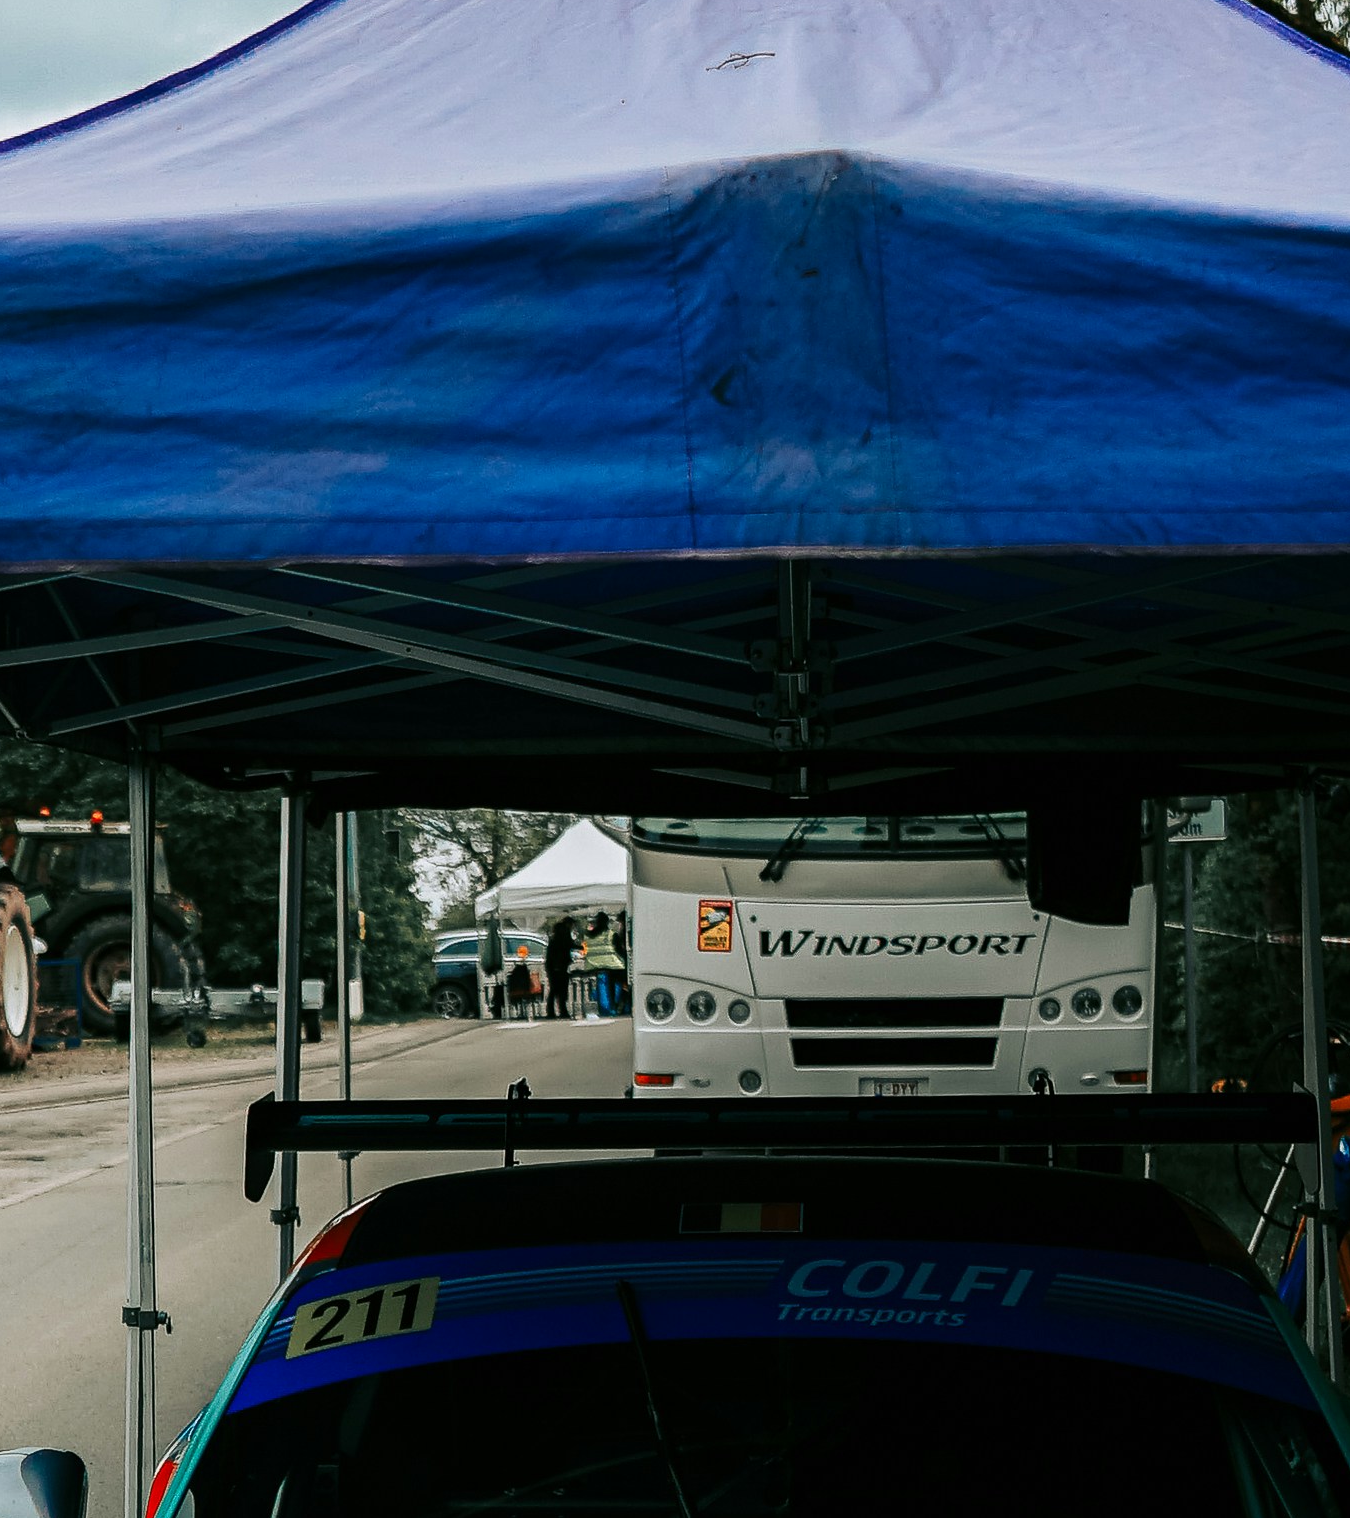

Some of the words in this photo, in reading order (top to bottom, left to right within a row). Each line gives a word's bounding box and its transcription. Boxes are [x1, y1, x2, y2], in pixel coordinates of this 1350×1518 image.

[758, 930, 1038, 957] WINDSPORT
[786, 1258, 1035, 1307] COLFI
[303, 1282, 422, 1352] 211
[777, 1302, 967, 1327] Transports
